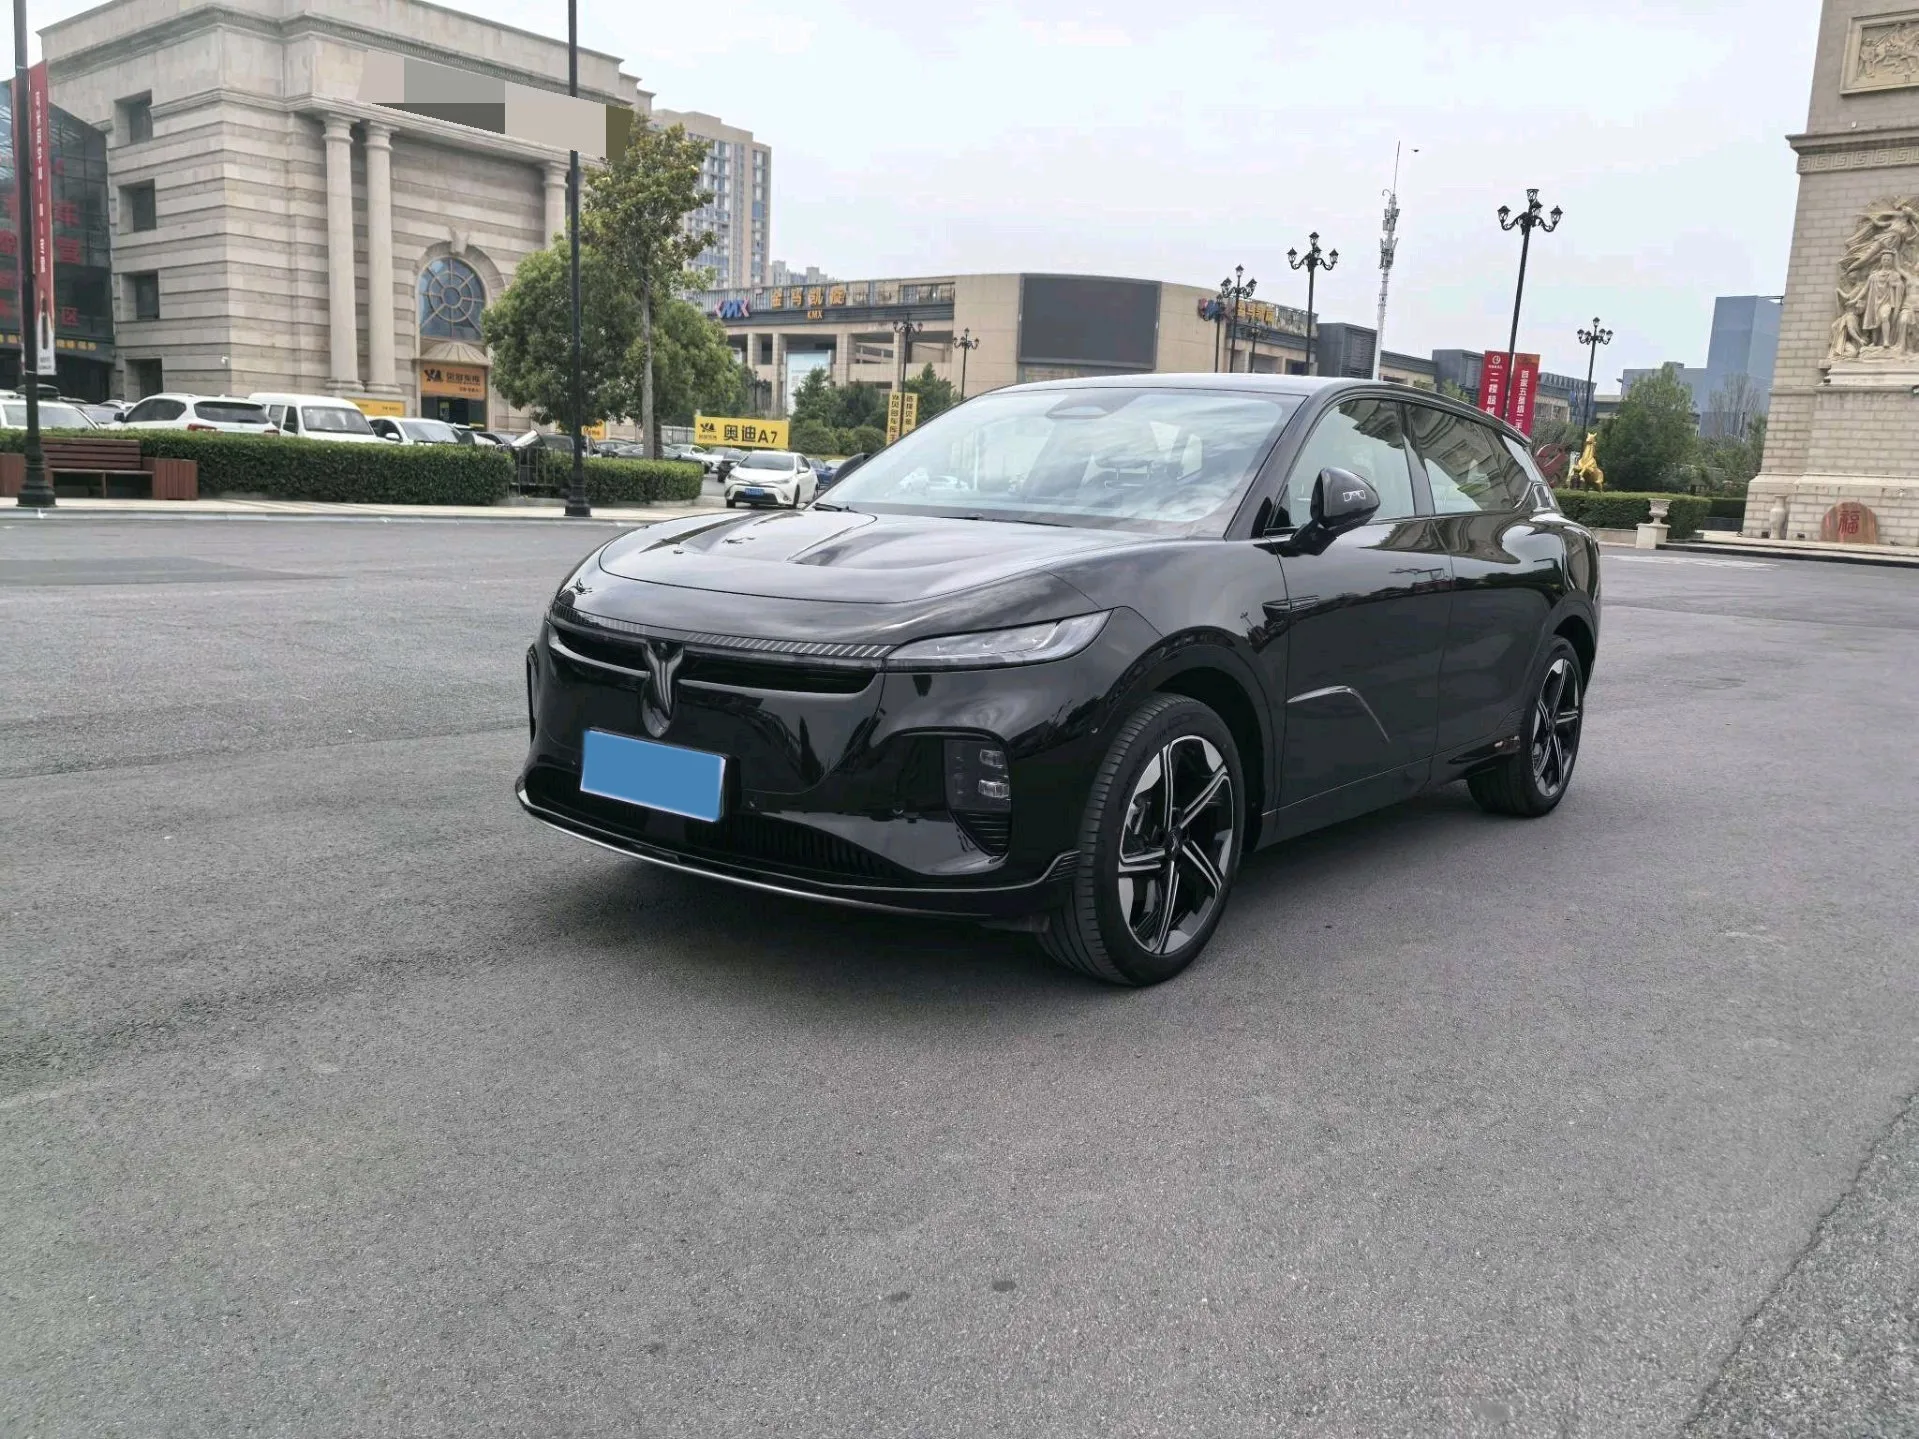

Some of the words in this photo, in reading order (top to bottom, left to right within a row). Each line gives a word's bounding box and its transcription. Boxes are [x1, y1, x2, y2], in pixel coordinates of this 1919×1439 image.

[771, 285, 846, 308] 金马凯旋
[807, 309, 824, 320] KMX
[724, 424, 778, 444] 奥迪A7
[1838, 510, 1861, 535] 福
